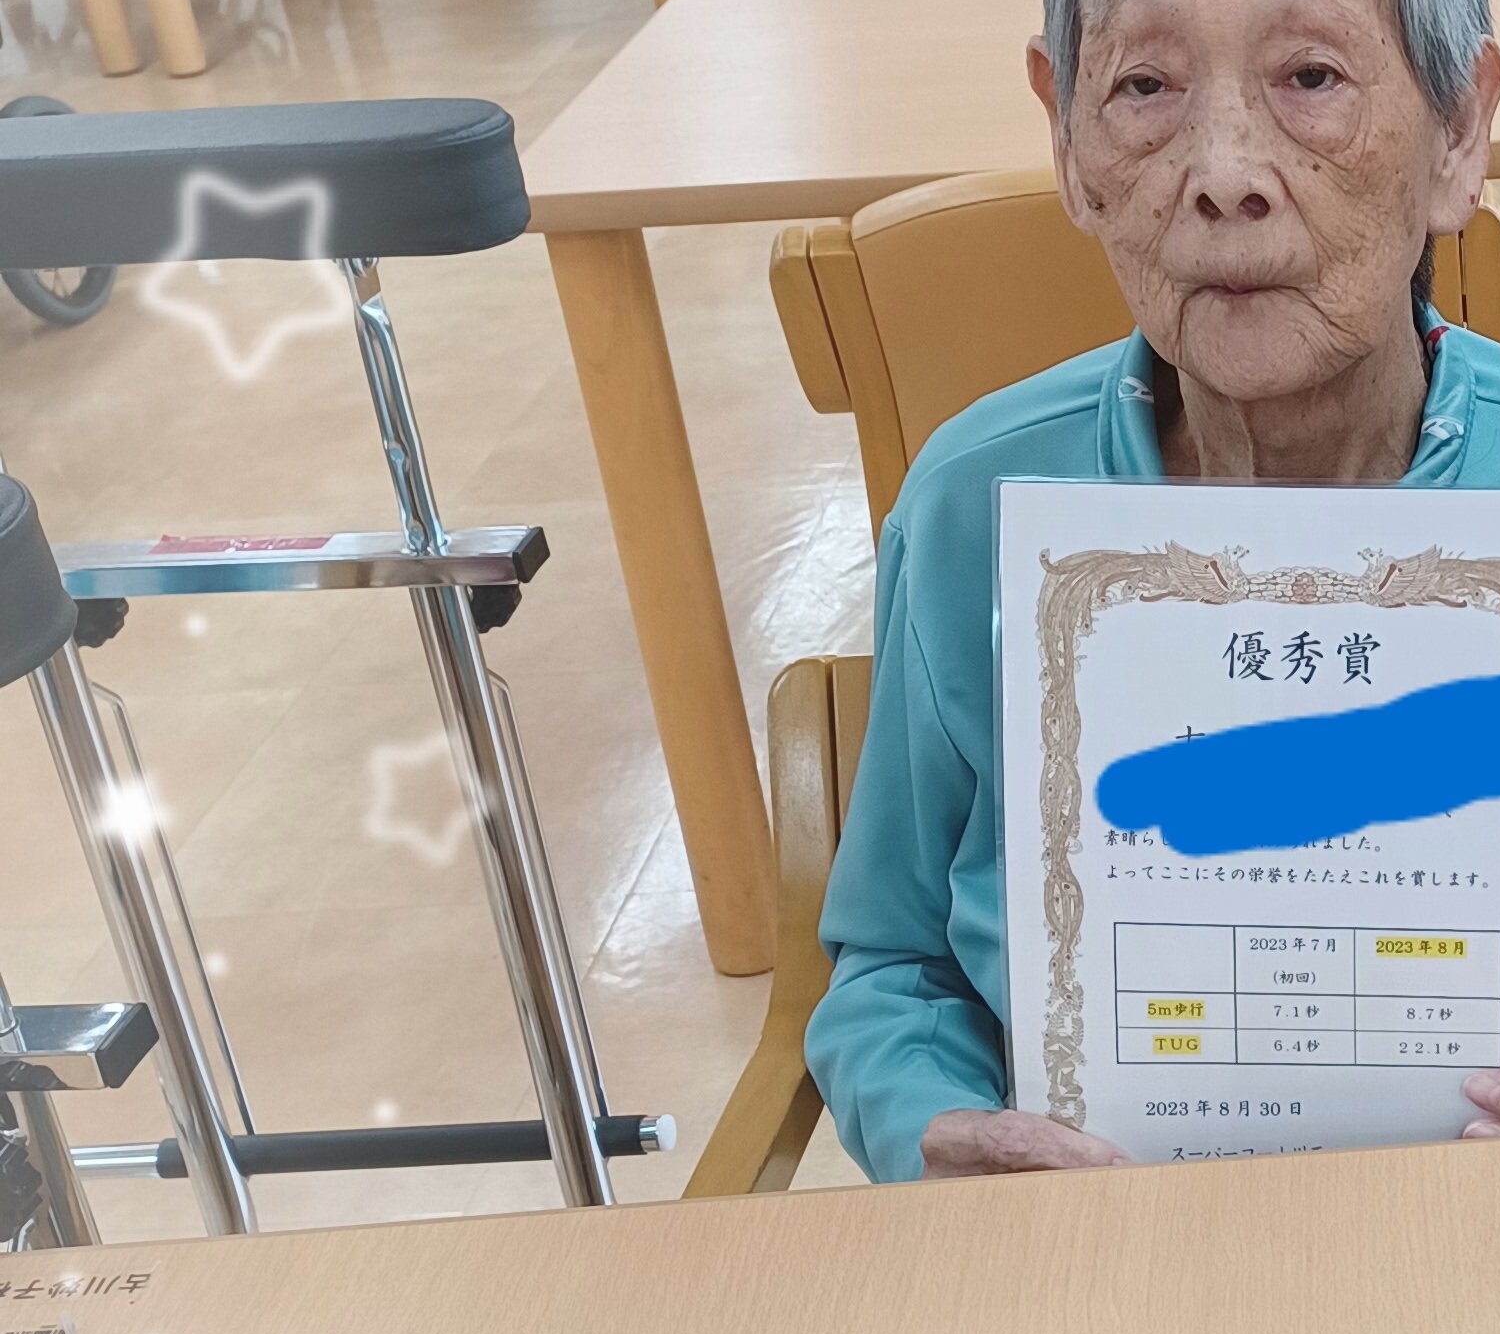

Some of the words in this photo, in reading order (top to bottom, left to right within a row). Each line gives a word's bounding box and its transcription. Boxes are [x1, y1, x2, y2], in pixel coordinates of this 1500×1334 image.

[1221, 630, 1382, 686] 優秀賞
[1106, 865, 1490, 890] よってここにその栄誉をたたえこれを賞します。
[1272, 969, 1317, 986] (初回)
[1147, 1002, 1205, 1018] 5m歩行
[1154, 1037, 1200, 1052] TUG
